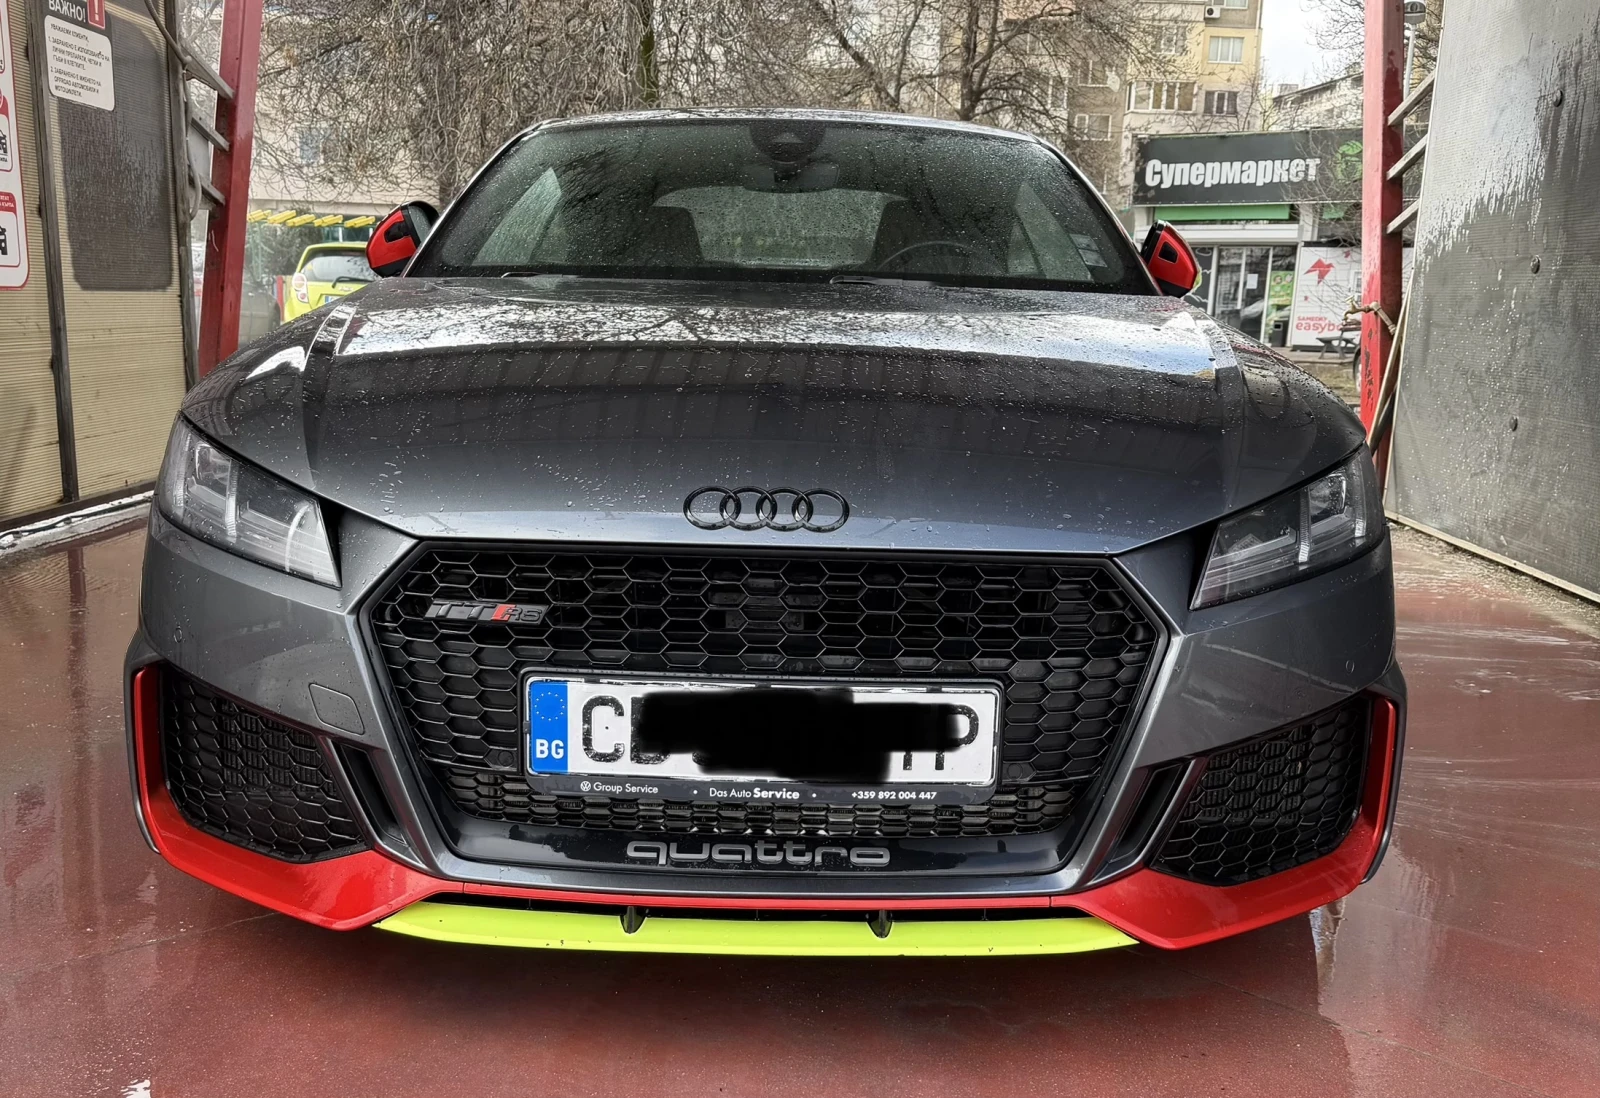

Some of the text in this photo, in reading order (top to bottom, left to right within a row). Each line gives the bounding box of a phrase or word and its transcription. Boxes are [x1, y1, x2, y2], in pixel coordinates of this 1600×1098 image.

[1145, 157, 1321, 189] Супермаркет
[535, 739, 564, 759] BG
[594, 782, 622, 794] Group
[625, 783, 658, 793] Service
[709, 787, 799, 799] Das Auto Service
[852, 791, 876, 799] +359
[878, 791, 896, 799] 892
[898, 791, 916, 799] 004
[626, 840, 890, 867] quattro
